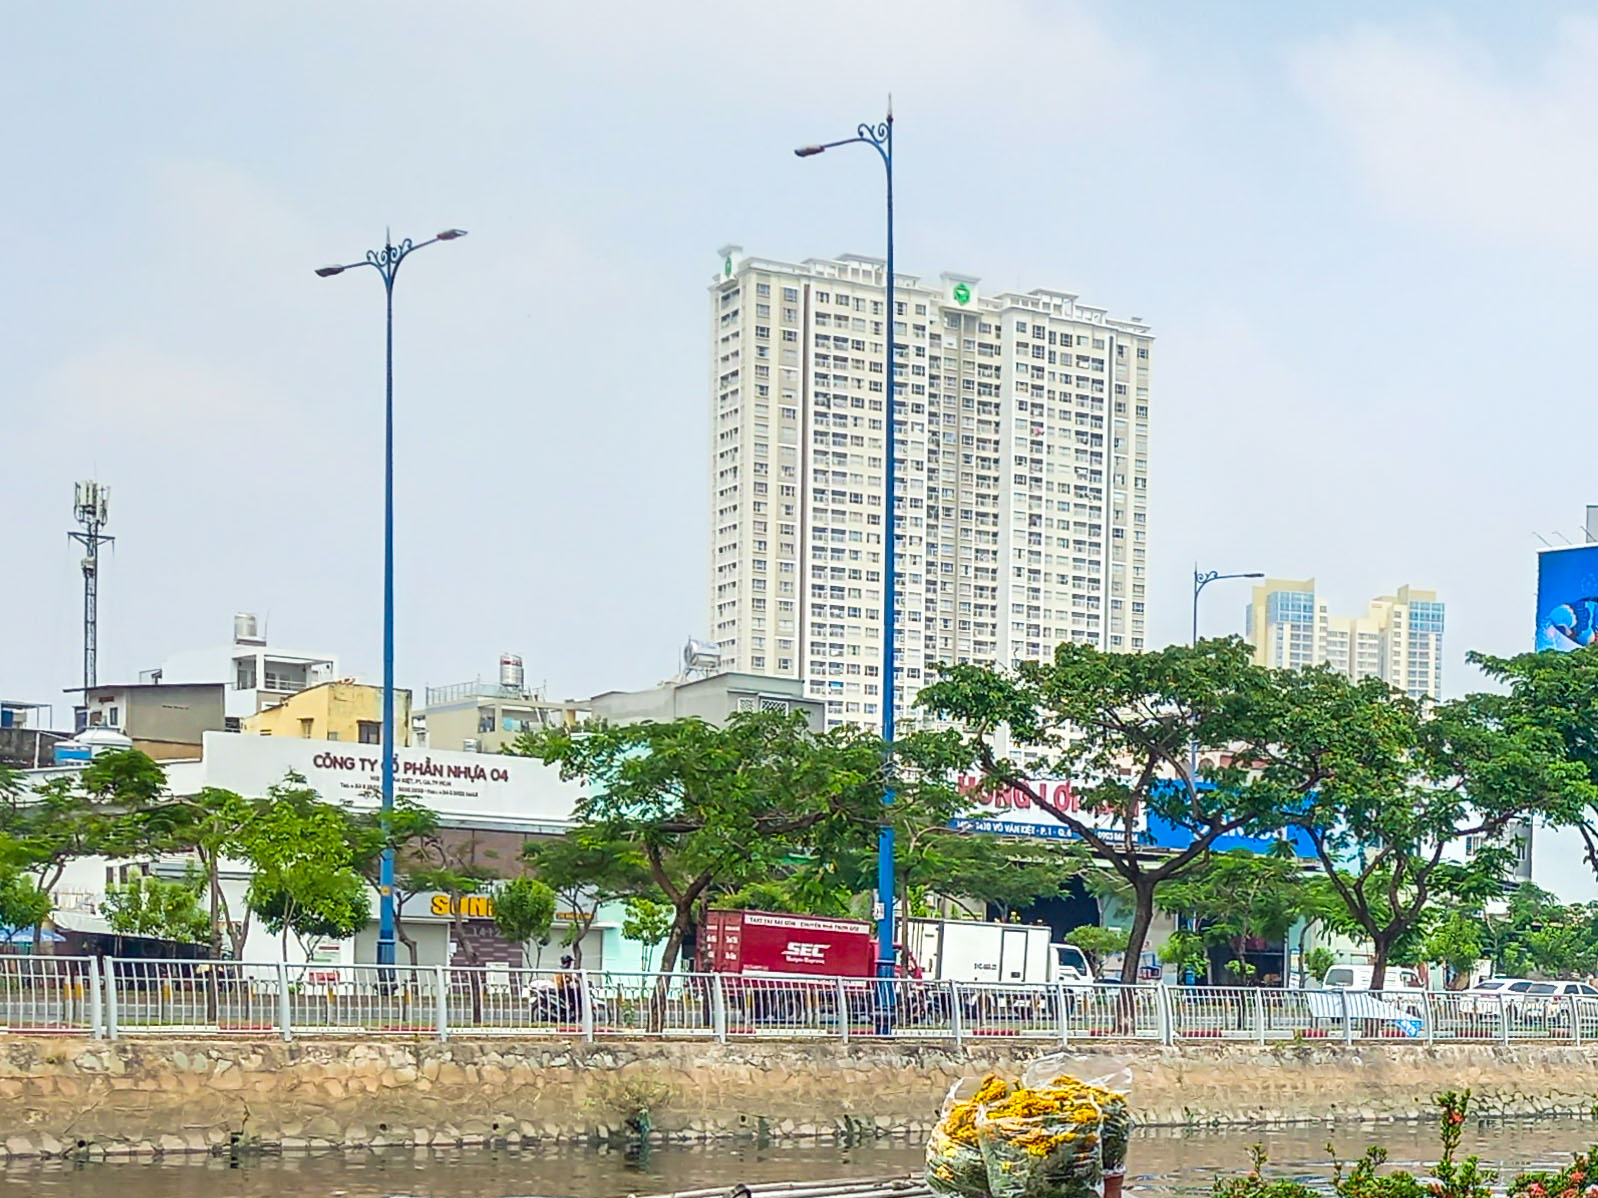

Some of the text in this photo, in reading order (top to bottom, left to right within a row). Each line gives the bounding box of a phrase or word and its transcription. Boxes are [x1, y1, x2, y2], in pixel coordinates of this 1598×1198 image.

[313, 752, 355, 771] CÔNG
[359, 757, 379, 772] TY
[404, 757, 444, 777] PHẦN
[447, 764, 487, 783] NHỰA
[491, 768, 509, 782] 04
[781, 942, 831, 957] SEC
